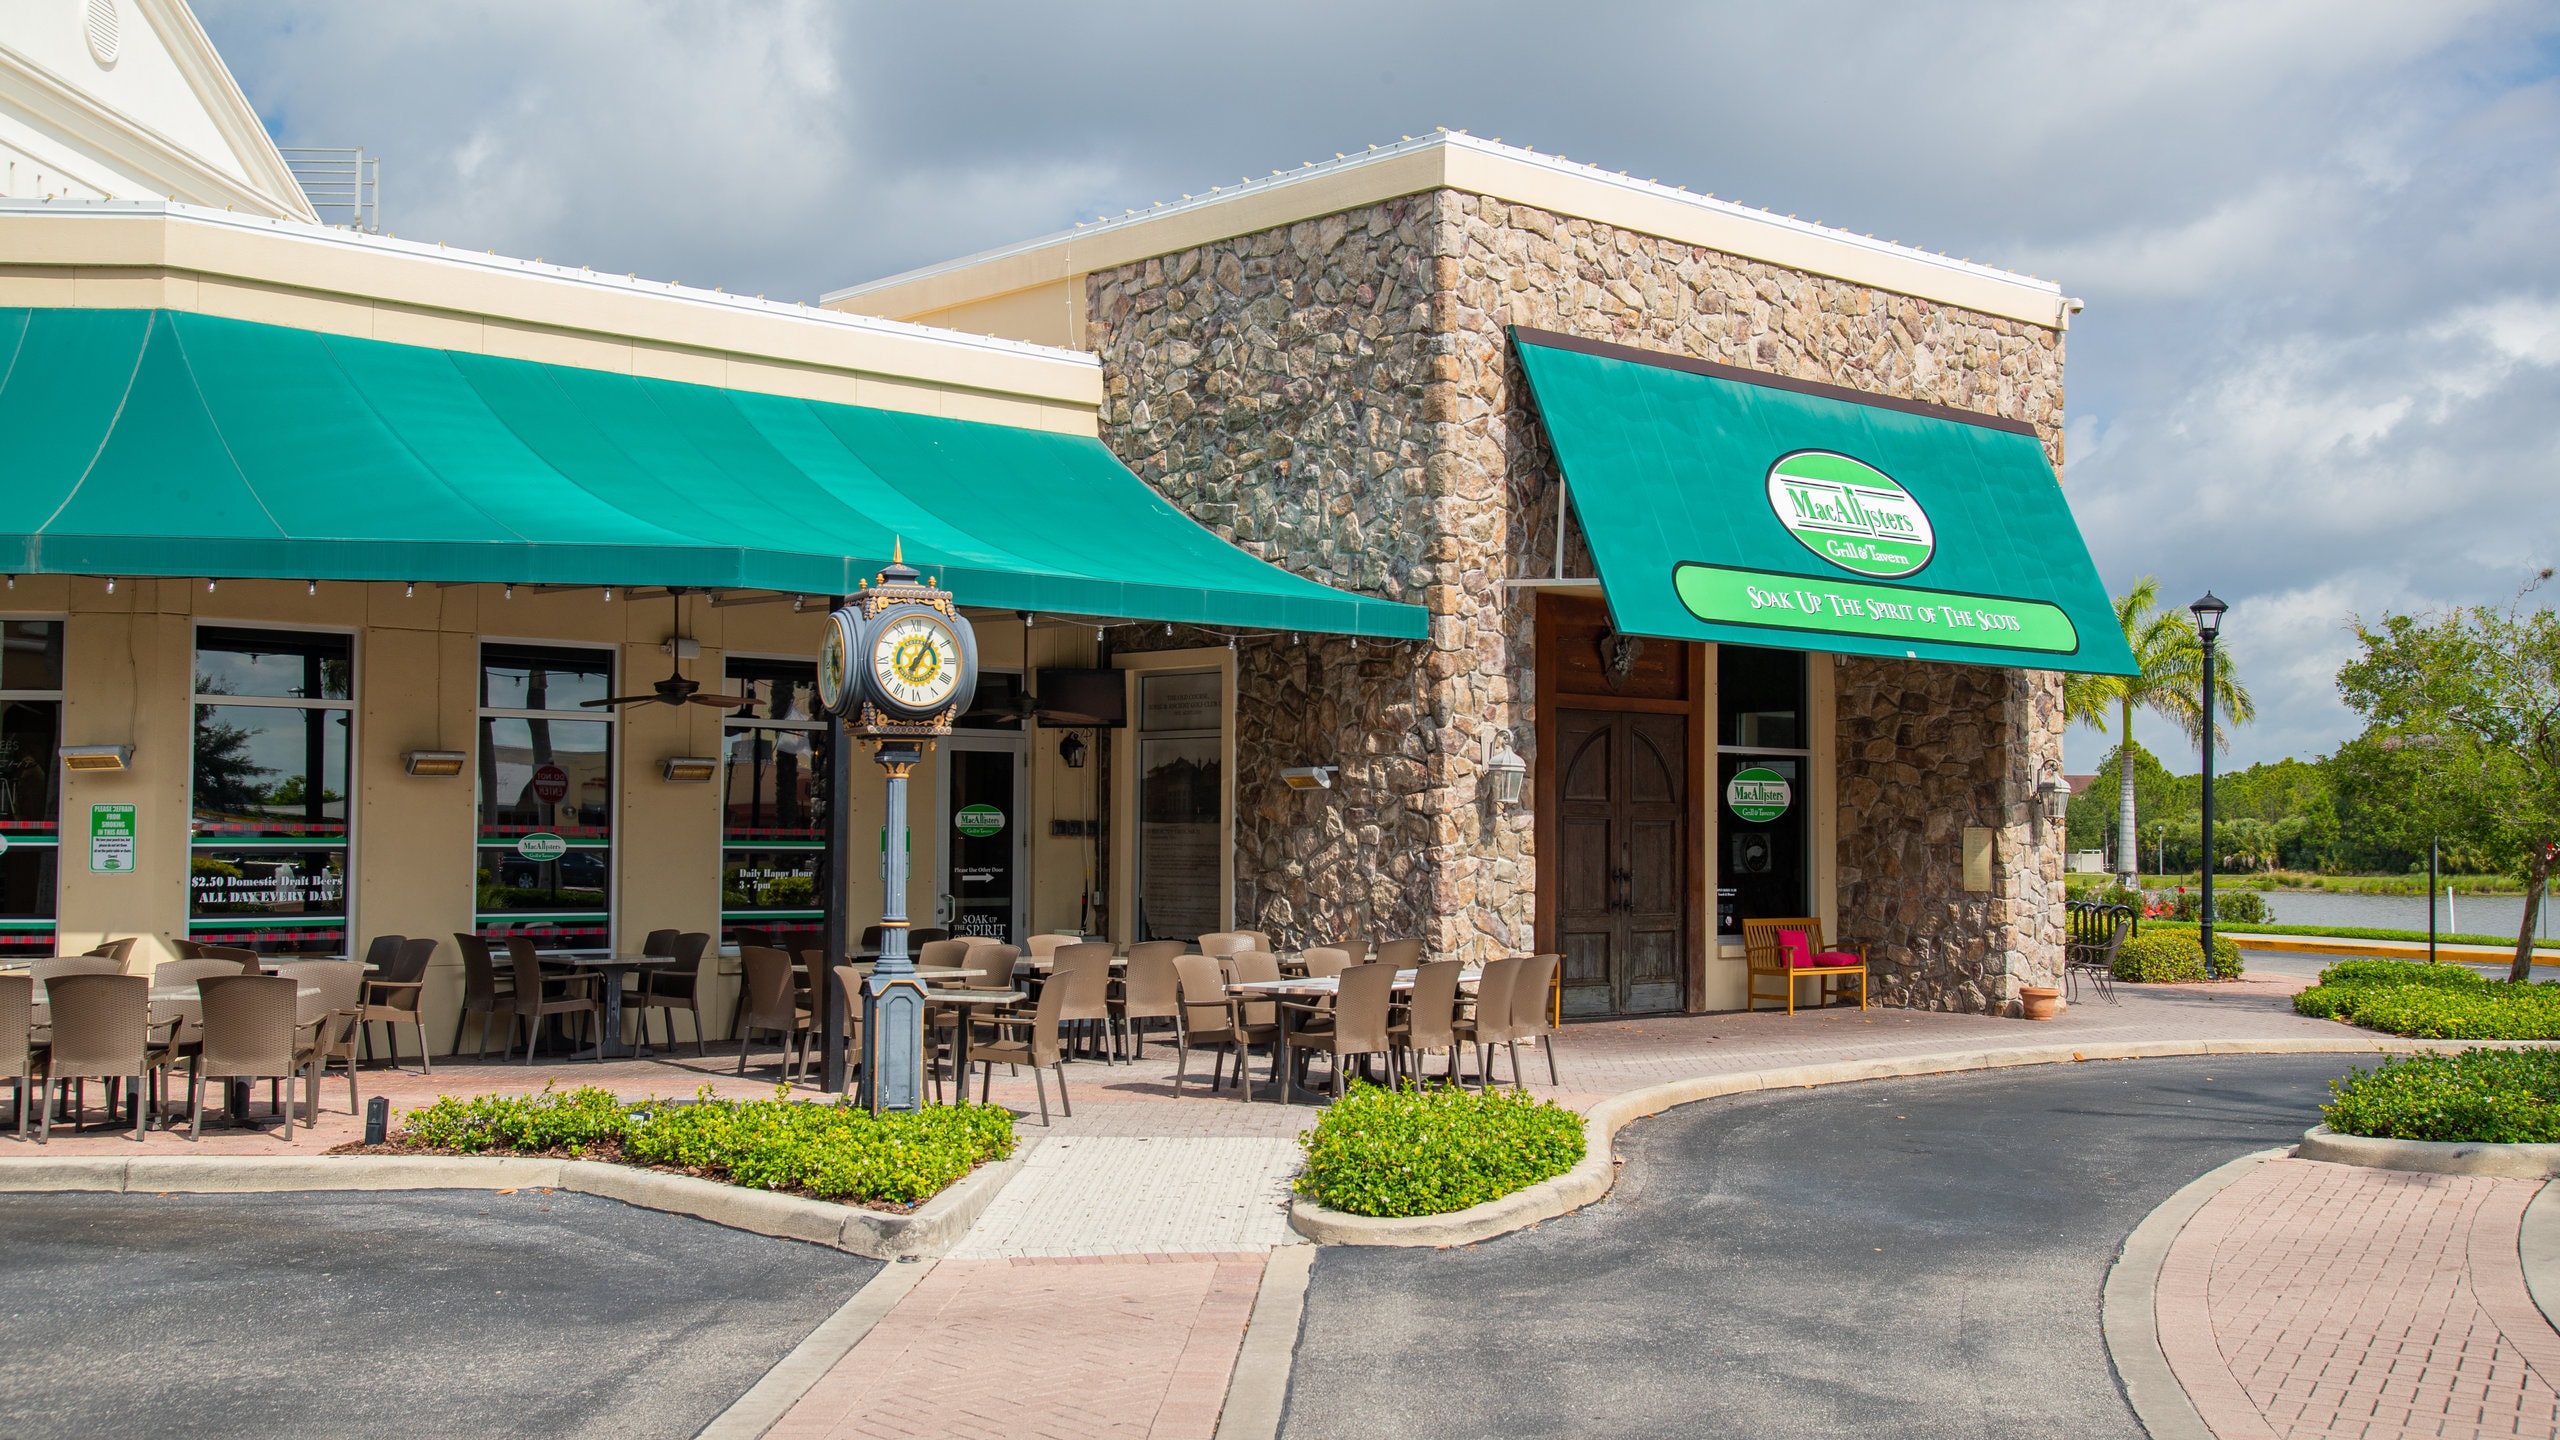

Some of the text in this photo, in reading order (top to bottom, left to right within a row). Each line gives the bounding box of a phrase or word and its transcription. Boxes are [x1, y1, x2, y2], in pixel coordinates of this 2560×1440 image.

[1786, 485, 1914, 539] MacAllisters
[1826, 539, 1910, 565] Grill & Tavern
[1747, 585, 2021, 632] SOAK UP THE SPIRIT OF THE SCOTS
[1735, 782, 1784, 804] MacAllisters
[739, 868, 813, 880] Daily Happy Hour
[191, 875, 343, 887] $2.50 Domestic Draft Beers
[738, 880, 745, 889] 3
[752, 880, 771, 892] 7pm
[198, 891, 335, 903] ALL DAY EVERY DAY
[962, 914, 989, 924] SOAK
[966, 923, 1006, 936] SPIRIT
